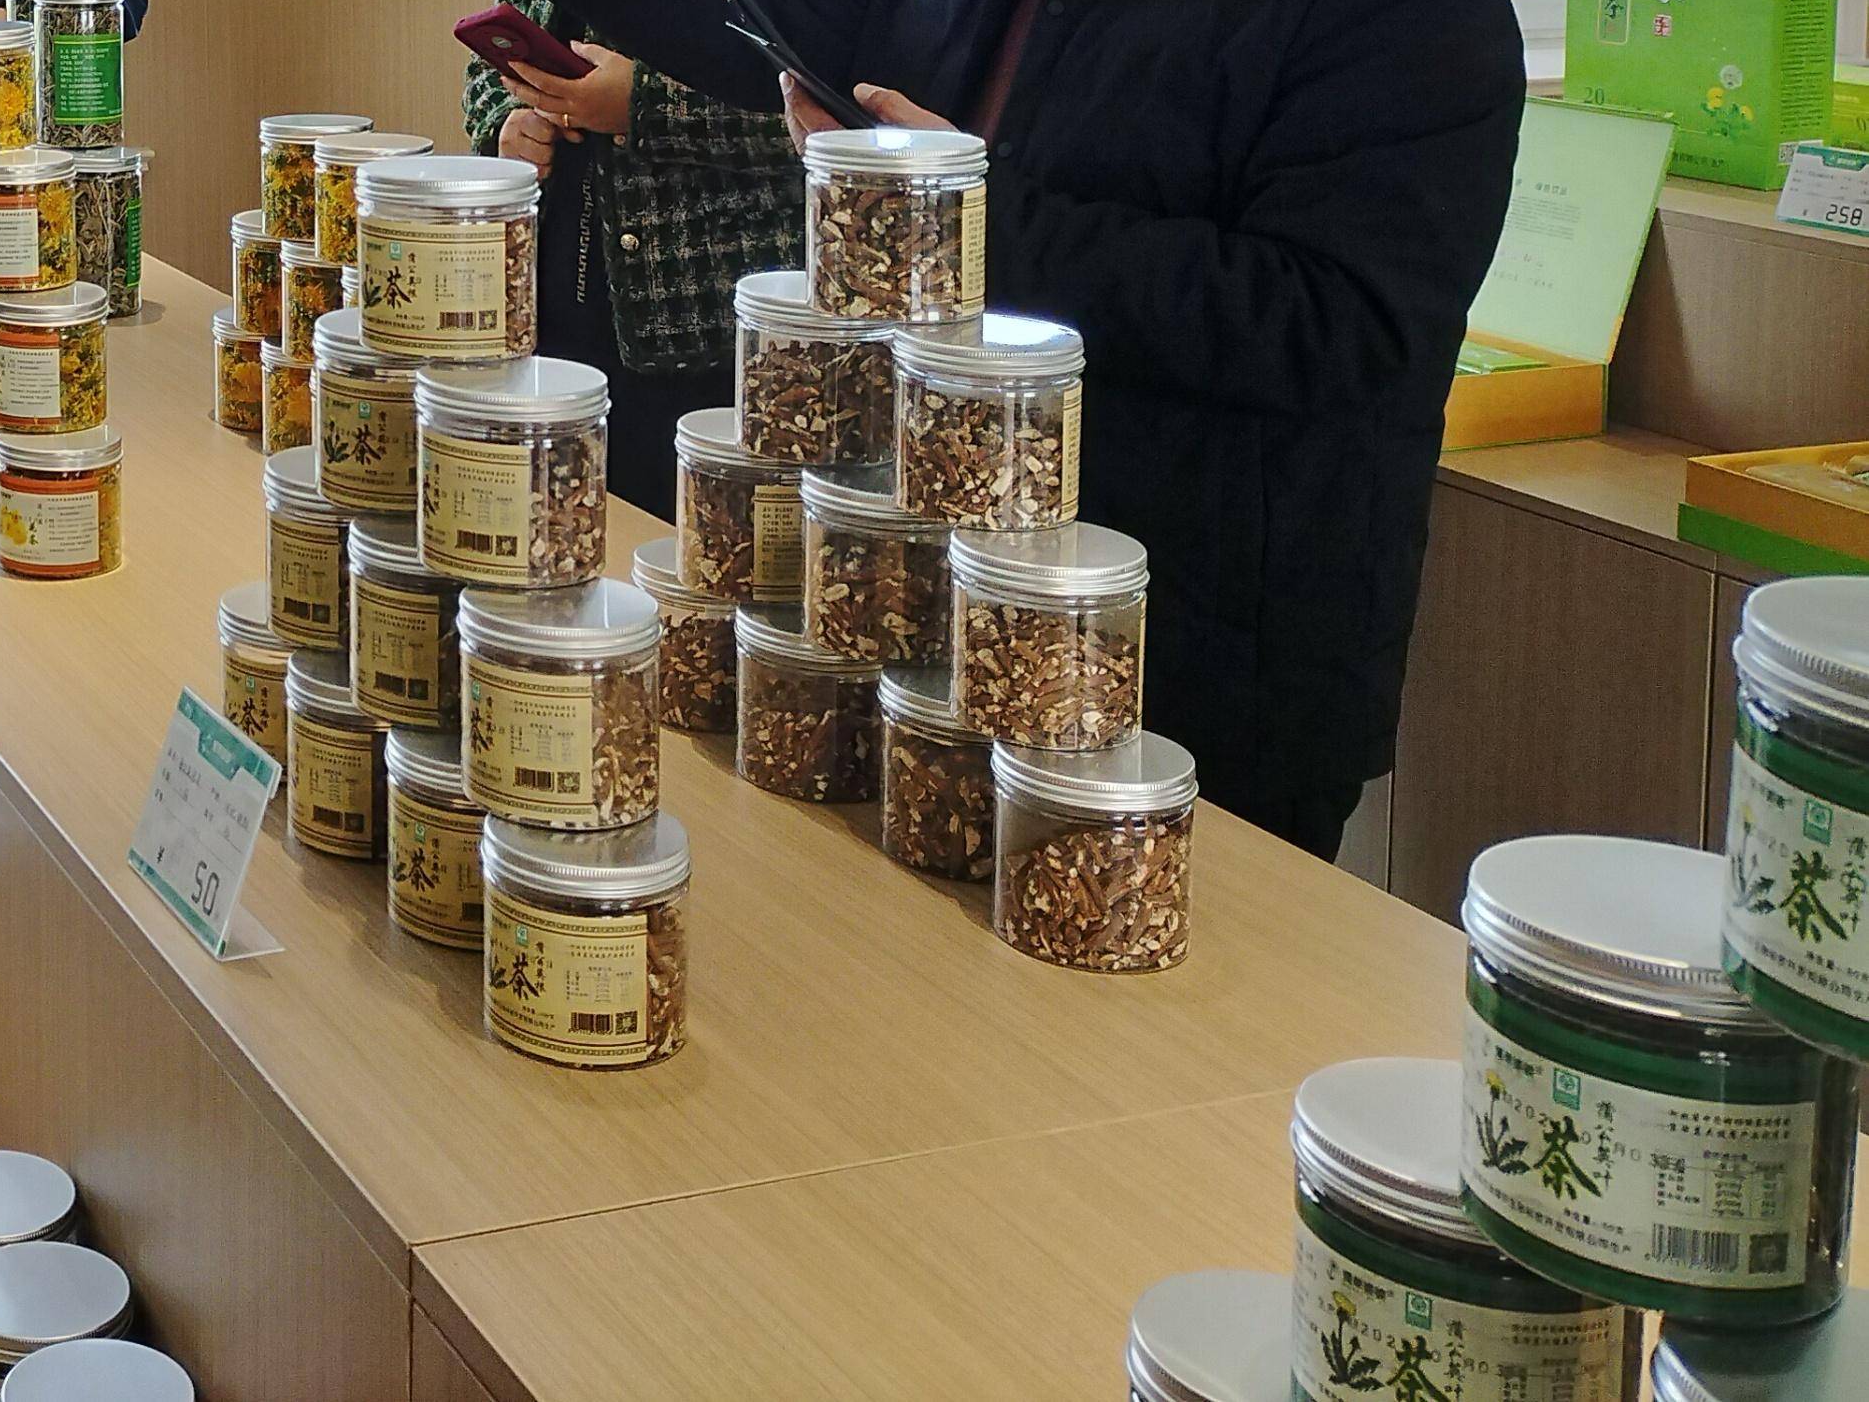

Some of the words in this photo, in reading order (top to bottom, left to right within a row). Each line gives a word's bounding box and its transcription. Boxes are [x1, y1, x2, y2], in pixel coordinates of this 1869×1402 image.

[1825, 203, 1863, 226] 258
[383, 265, 413, 310] 茶
[1780, 850, 1848, 943] 茶
[509, 951, 541, 1001] 茶
[1533, 1115, 1603, 1200] 茶
